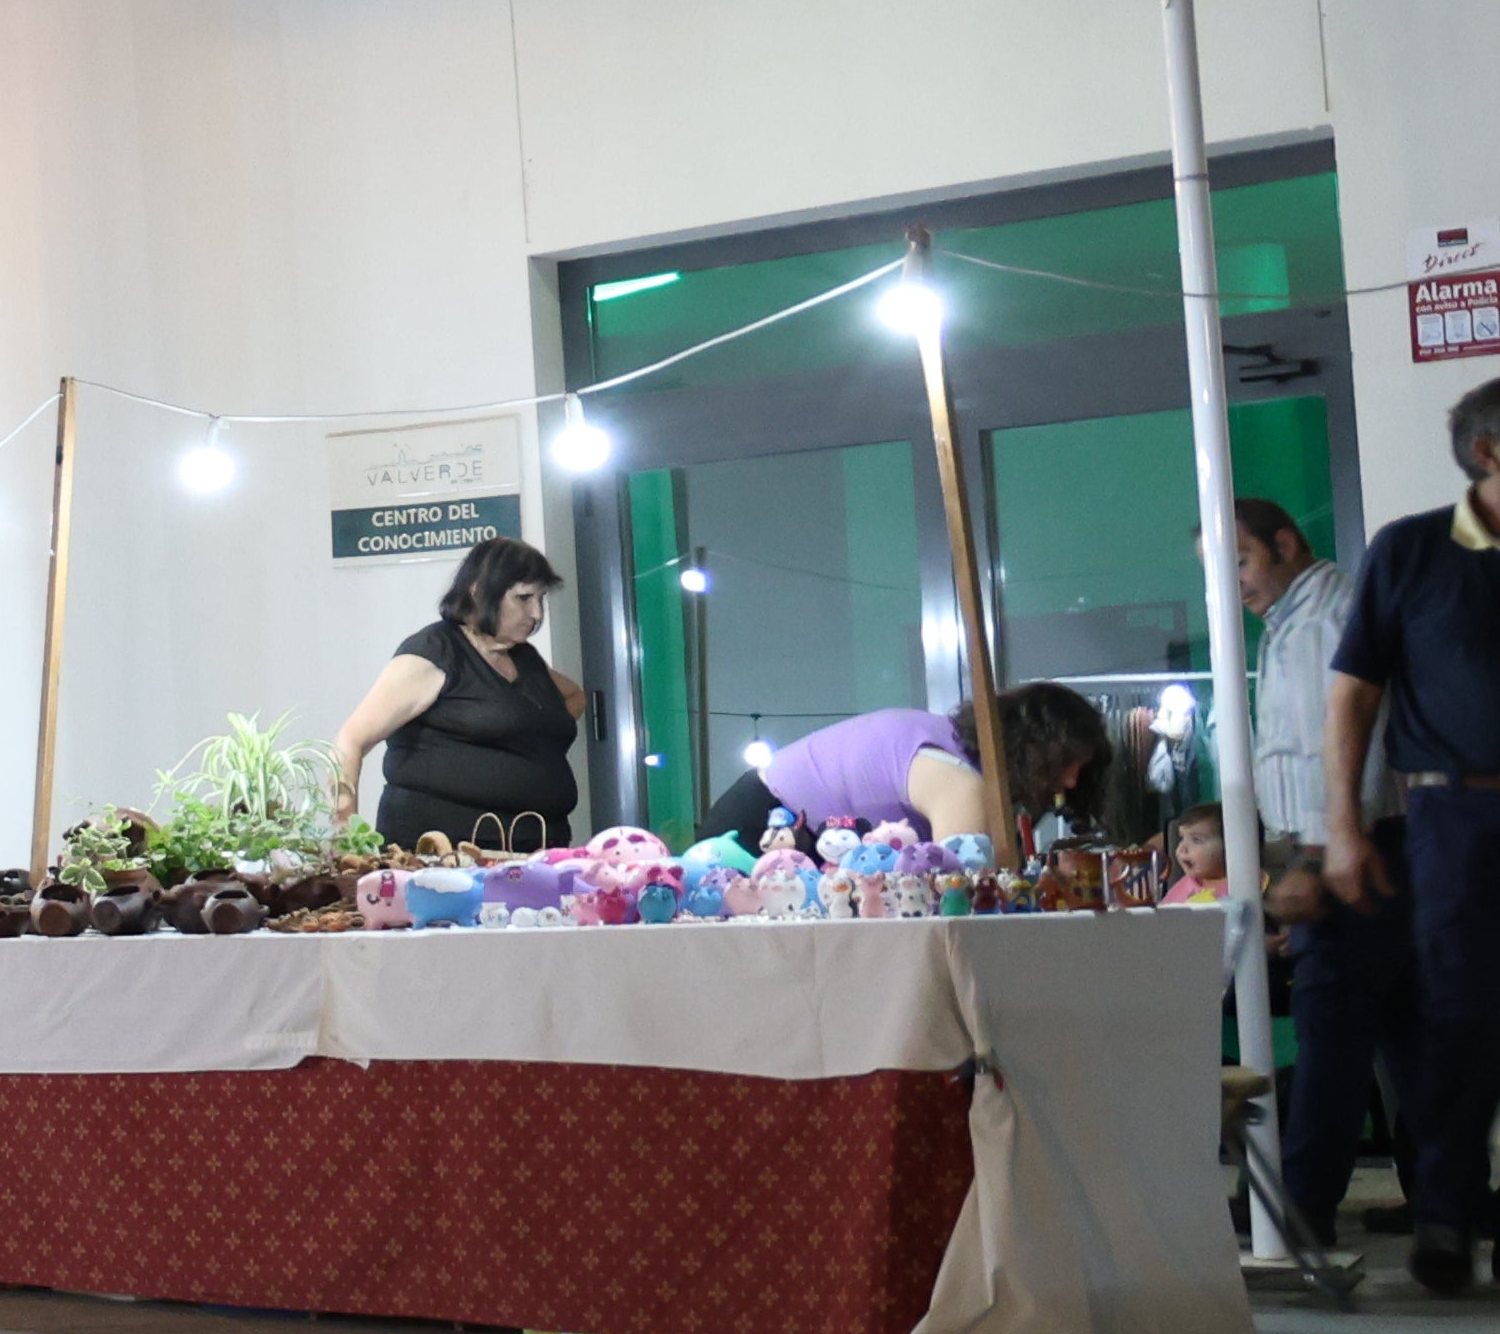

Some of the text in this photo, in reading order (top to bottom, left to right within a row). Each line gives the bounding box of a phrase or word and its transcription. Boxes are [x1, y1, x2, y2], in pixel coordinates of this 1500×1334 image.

[1416, 279, 1498, 303] Alarma
[367, 460, 483, 487] VALVERDE
[372, 503, 479, 527] CENTRO DEL
[358, 526, 497, 552] CONOCIMIENTO
